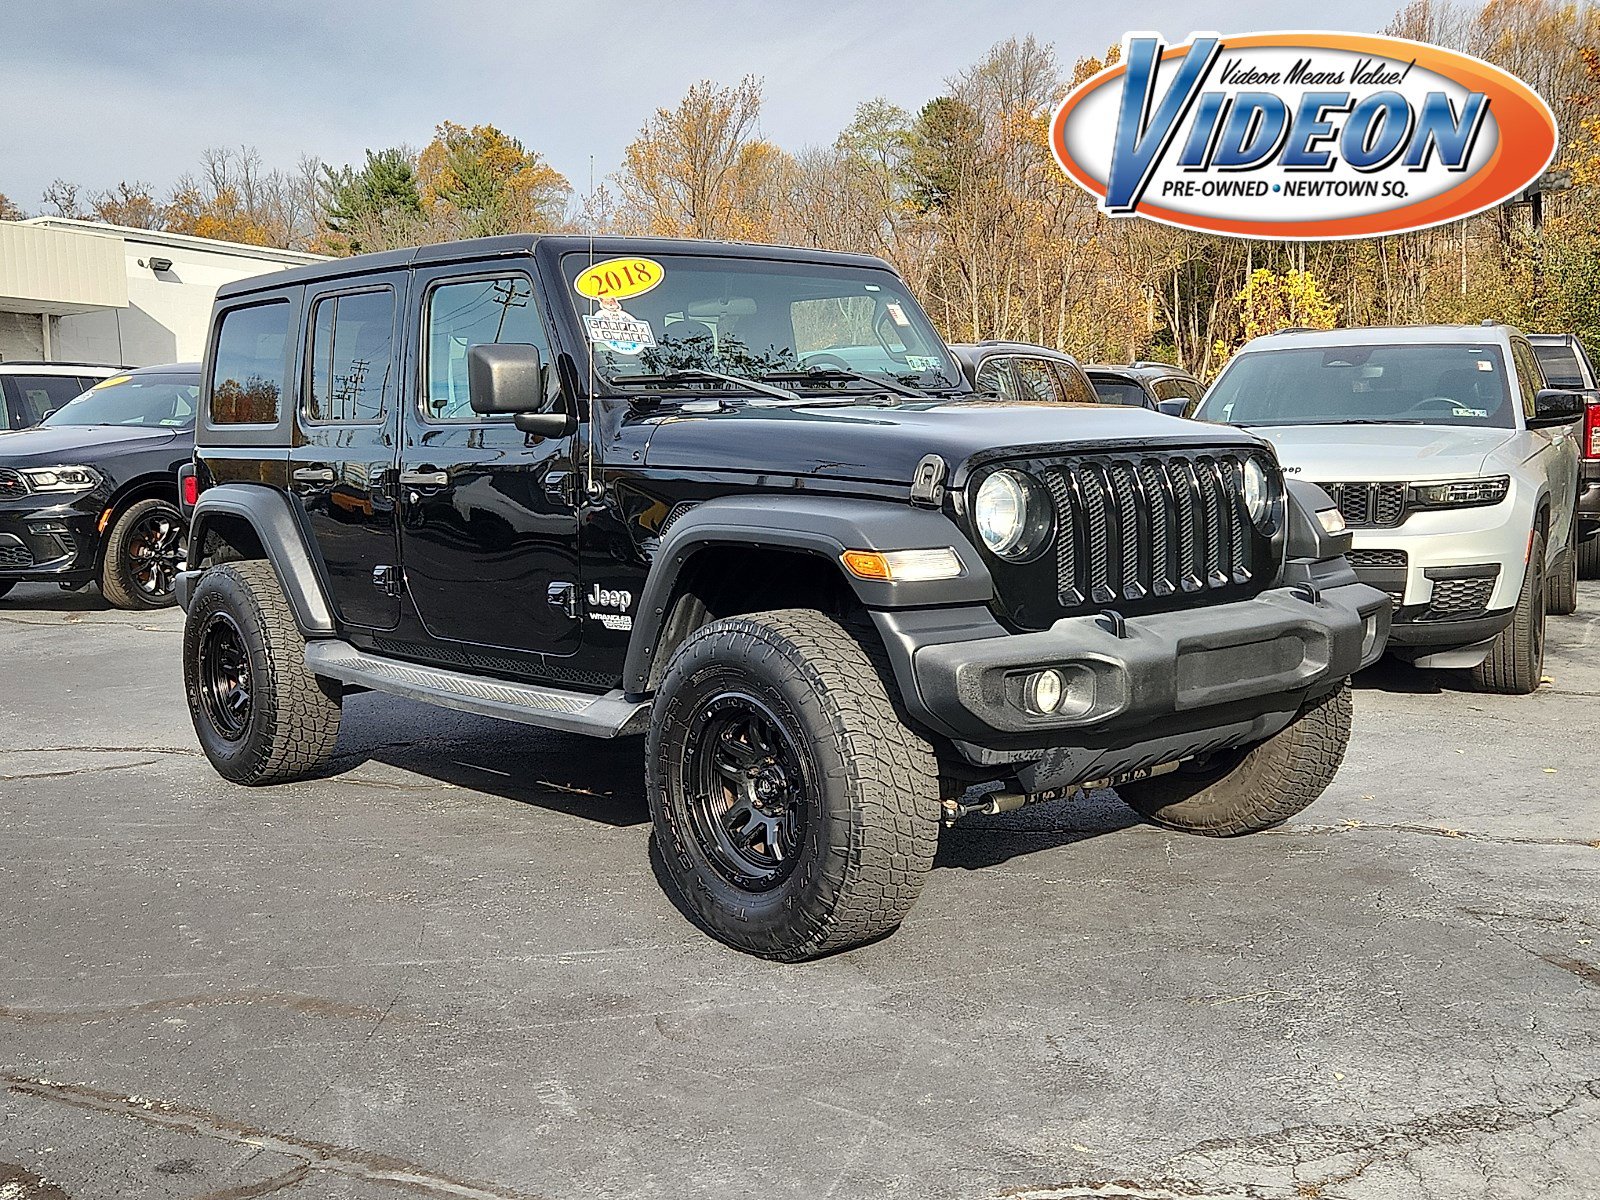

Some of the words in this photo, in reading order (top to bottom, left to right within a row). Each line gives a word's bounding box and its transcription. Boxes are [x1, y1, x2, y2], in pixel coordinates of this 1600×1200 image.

[589, 262, 652, 296] 2018
[589, 320, 645, 333] CARFAX
[1279, 466, 1302, 475] eep
[587, 583, 632, 613] Jeep
